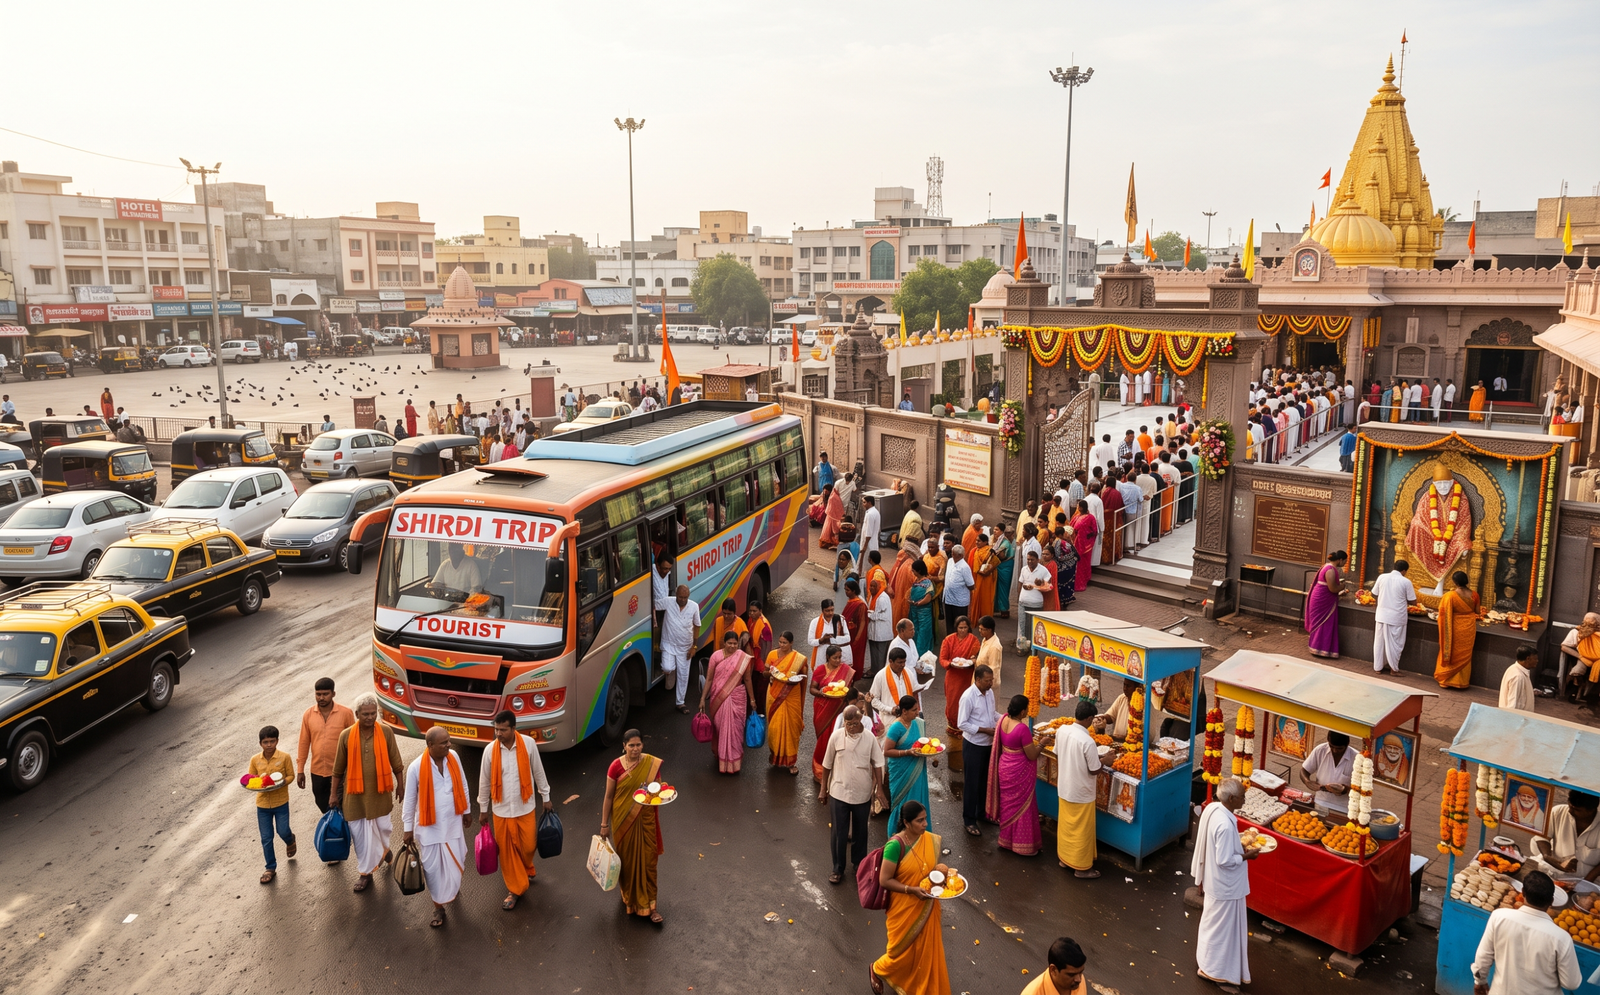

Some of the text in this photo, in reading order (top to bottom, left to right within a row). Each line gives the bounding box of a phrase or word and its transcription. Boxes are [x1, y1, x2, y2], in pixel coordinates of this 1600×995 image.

[121, 201, 158, 212] HOTEL
[396, 512, 557, 543] SHIRDI TRIP
[687, 533, 742, 582] SHIRDI TRIP
[414, 617, 506, 639] TOURIST
